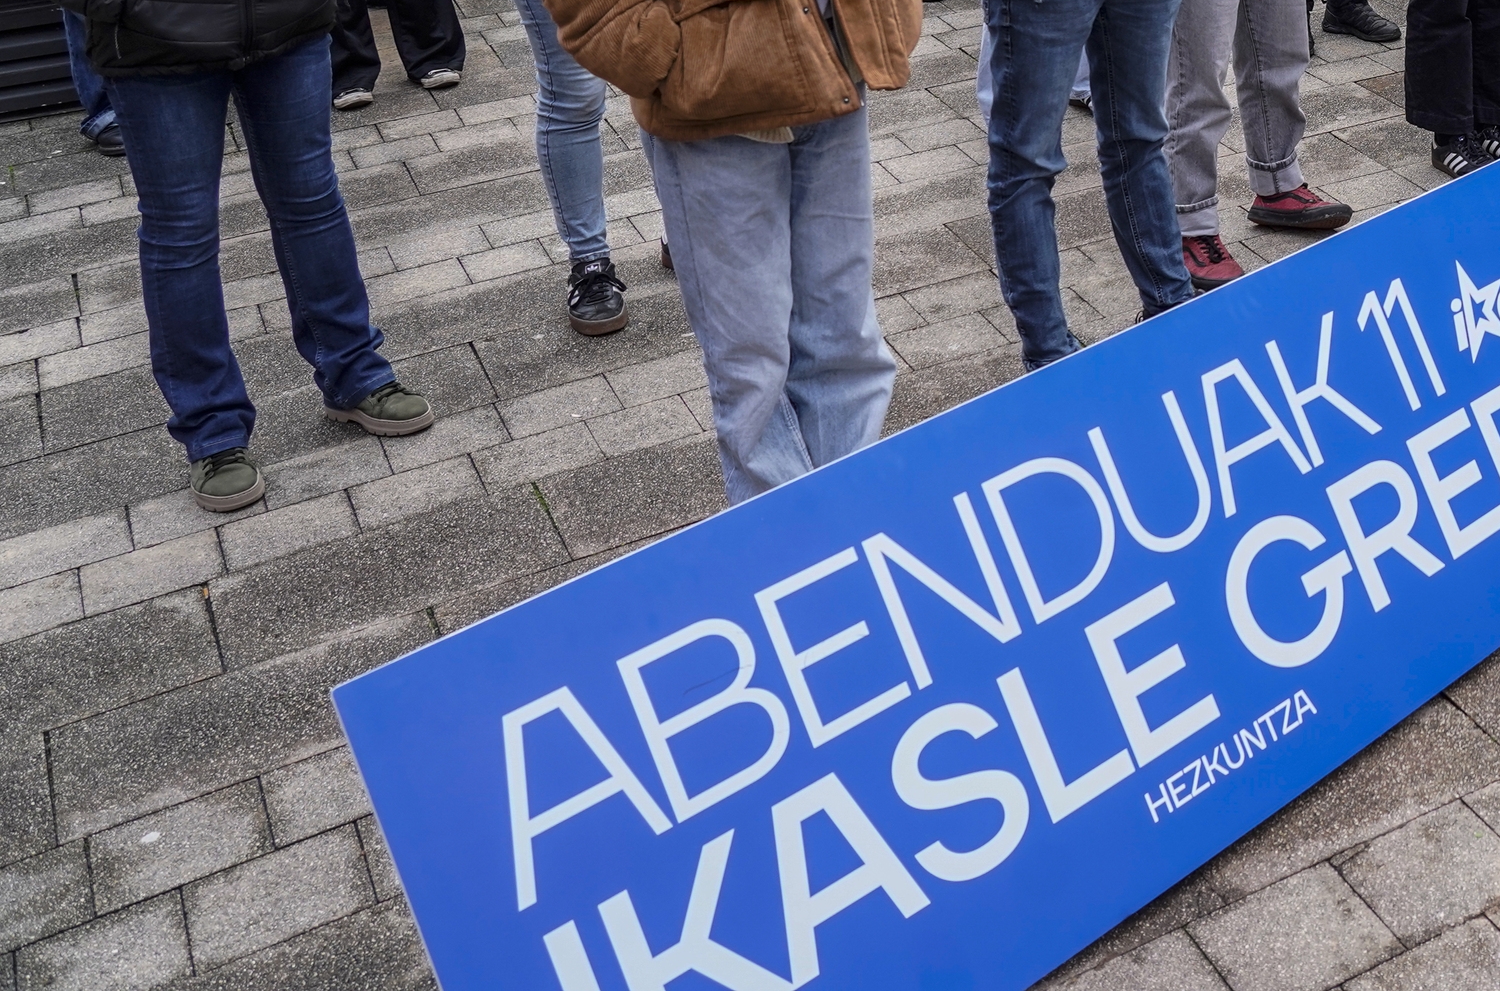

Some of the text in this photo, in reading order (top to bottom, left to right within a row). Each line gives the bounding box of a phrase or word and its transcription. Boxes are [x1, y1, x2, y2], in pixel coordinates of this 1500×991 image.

[502, 277, 1446, 911] ABENDUAK 11
[1145, 689, 1317, 823] HEZKUNTZA
